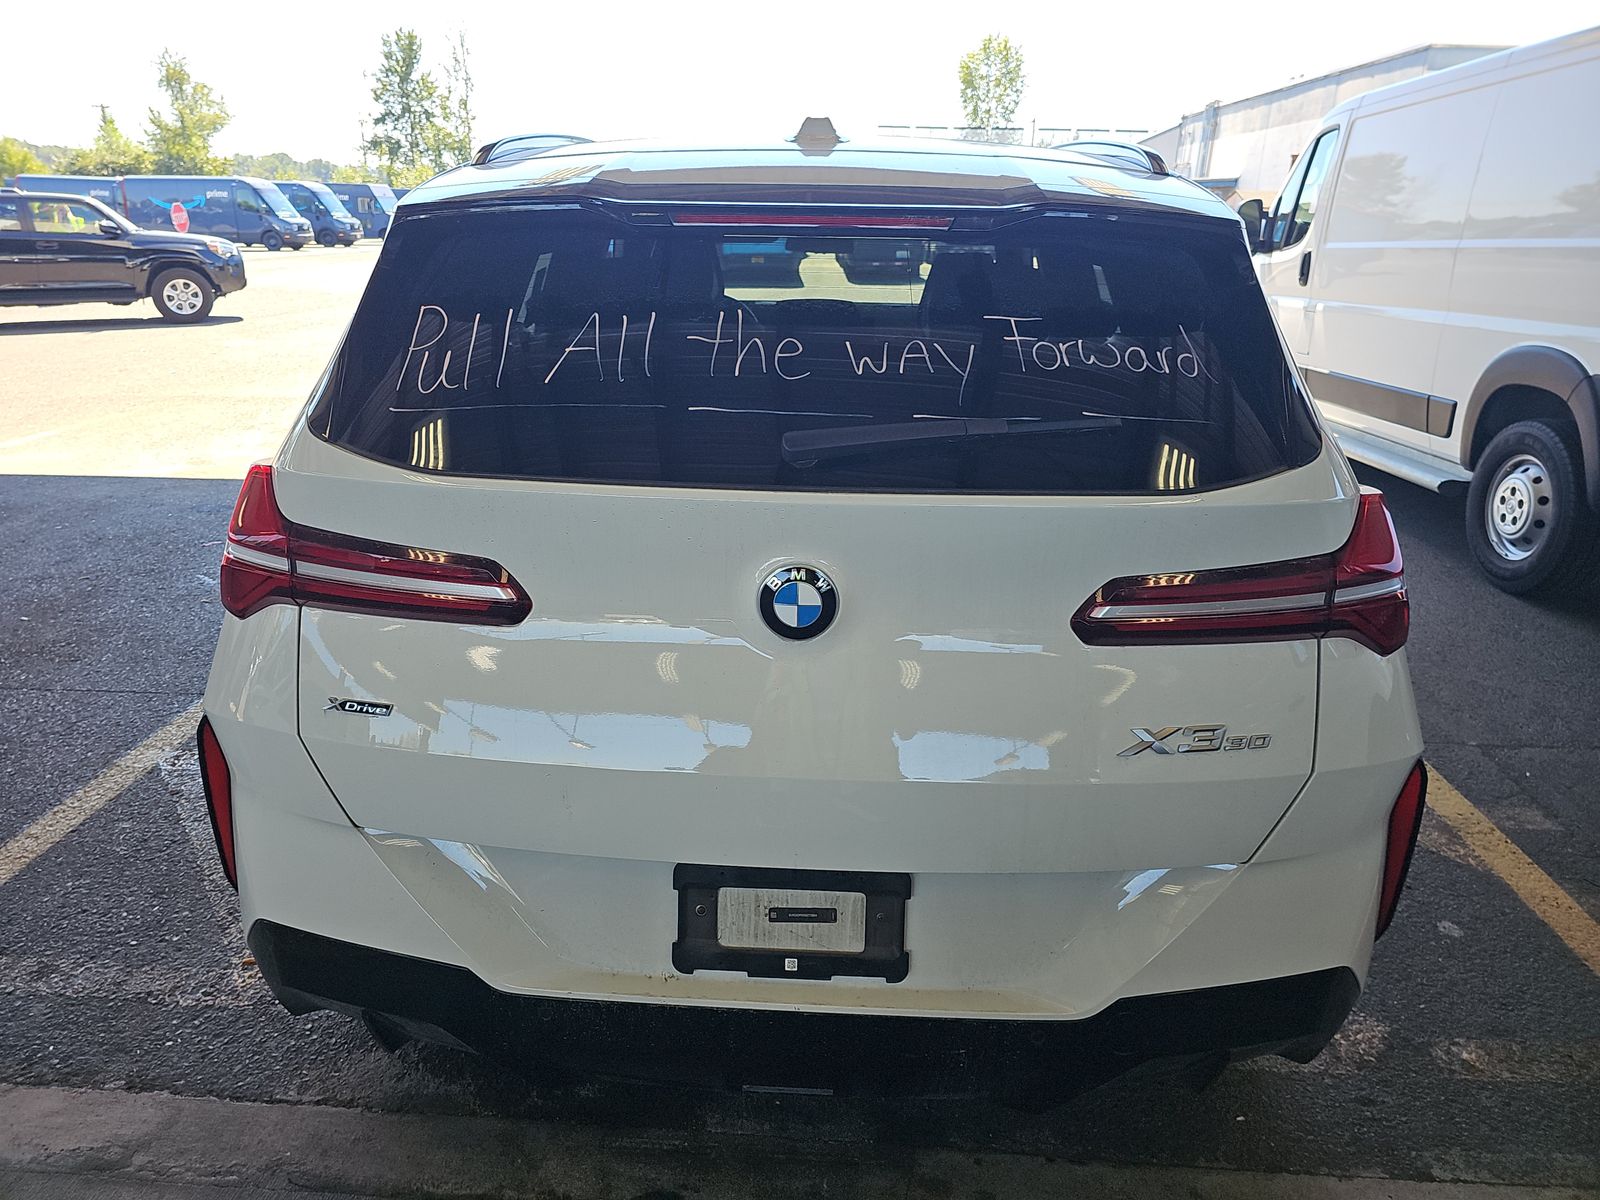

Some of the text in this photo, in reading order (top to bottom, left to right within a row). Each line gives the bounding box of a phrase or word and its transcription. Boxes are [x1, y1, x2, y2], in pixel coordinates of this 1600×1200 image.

[206, 189, 228, 199] prime
[396, 305, 515, 394] Pull
[543, 311, 656, 383] All
[686, 308, 811, 380] the
[983, 314, 1219, 384] Forward
[766, 568, 832, 594] BMW
